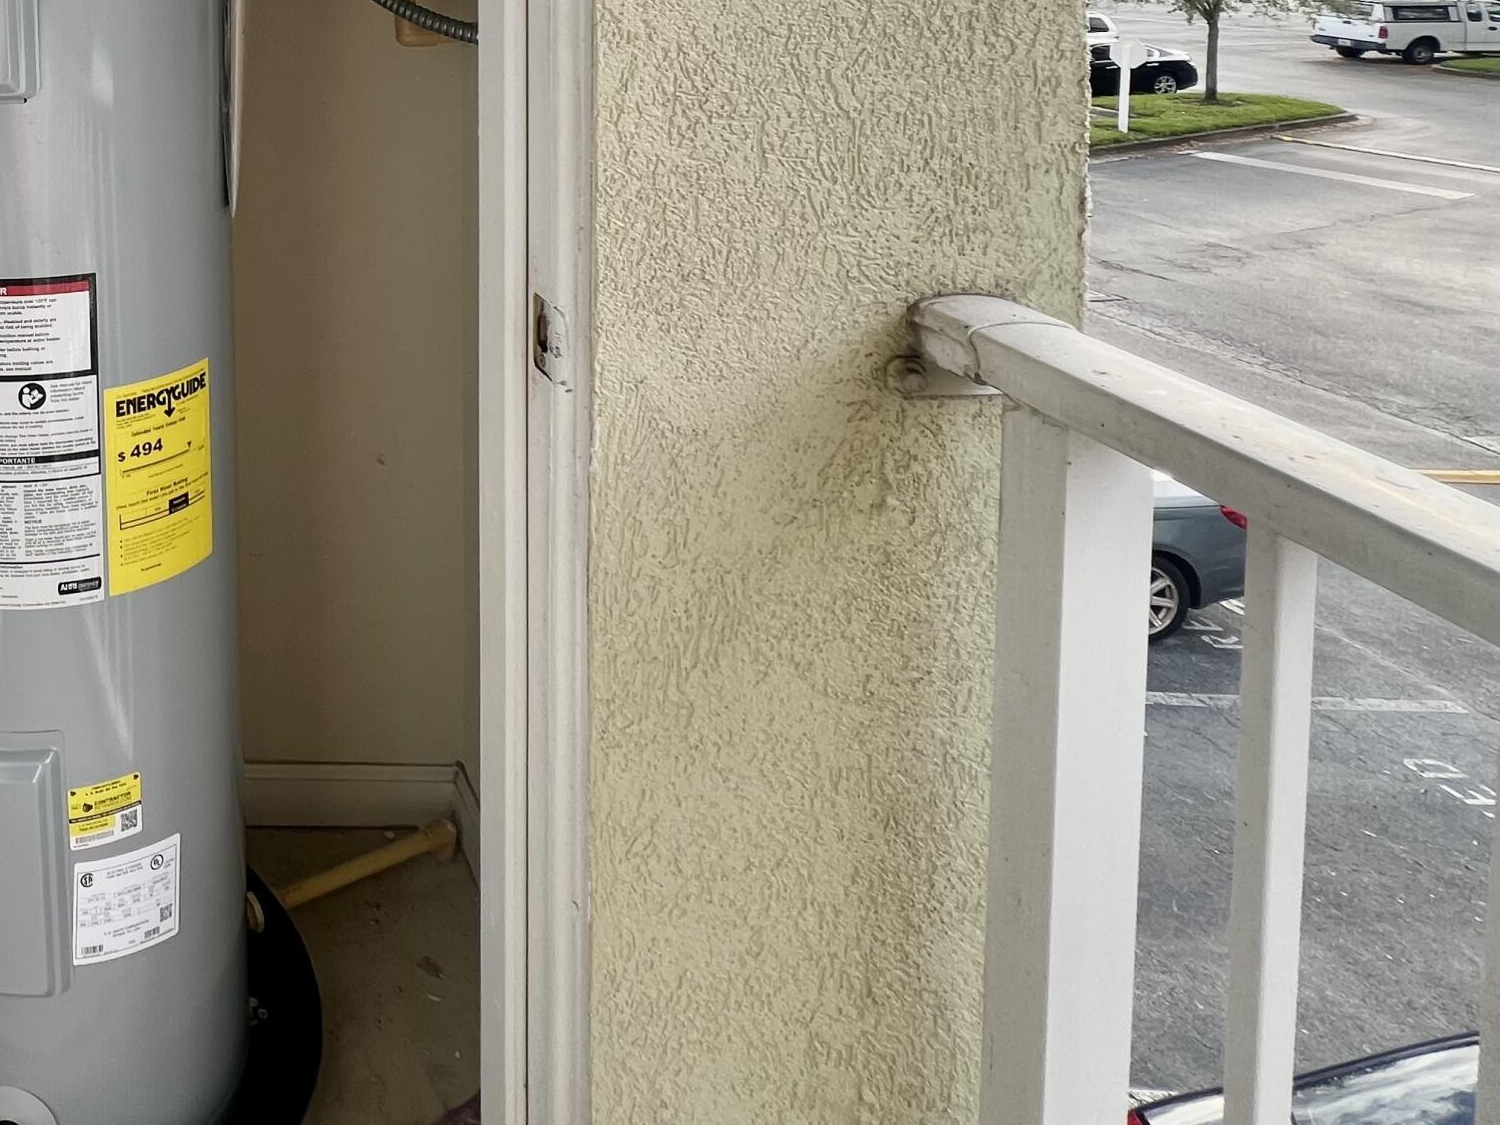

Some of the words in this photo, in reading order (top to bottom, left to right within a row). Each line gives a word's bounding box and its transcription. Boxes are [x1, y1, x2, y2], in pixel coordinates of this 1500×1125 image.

[116, 371, 206, 417] ENERGYGUIDE
[117, 451, 126, 463] $
[130, 437, 163, 458] 494
